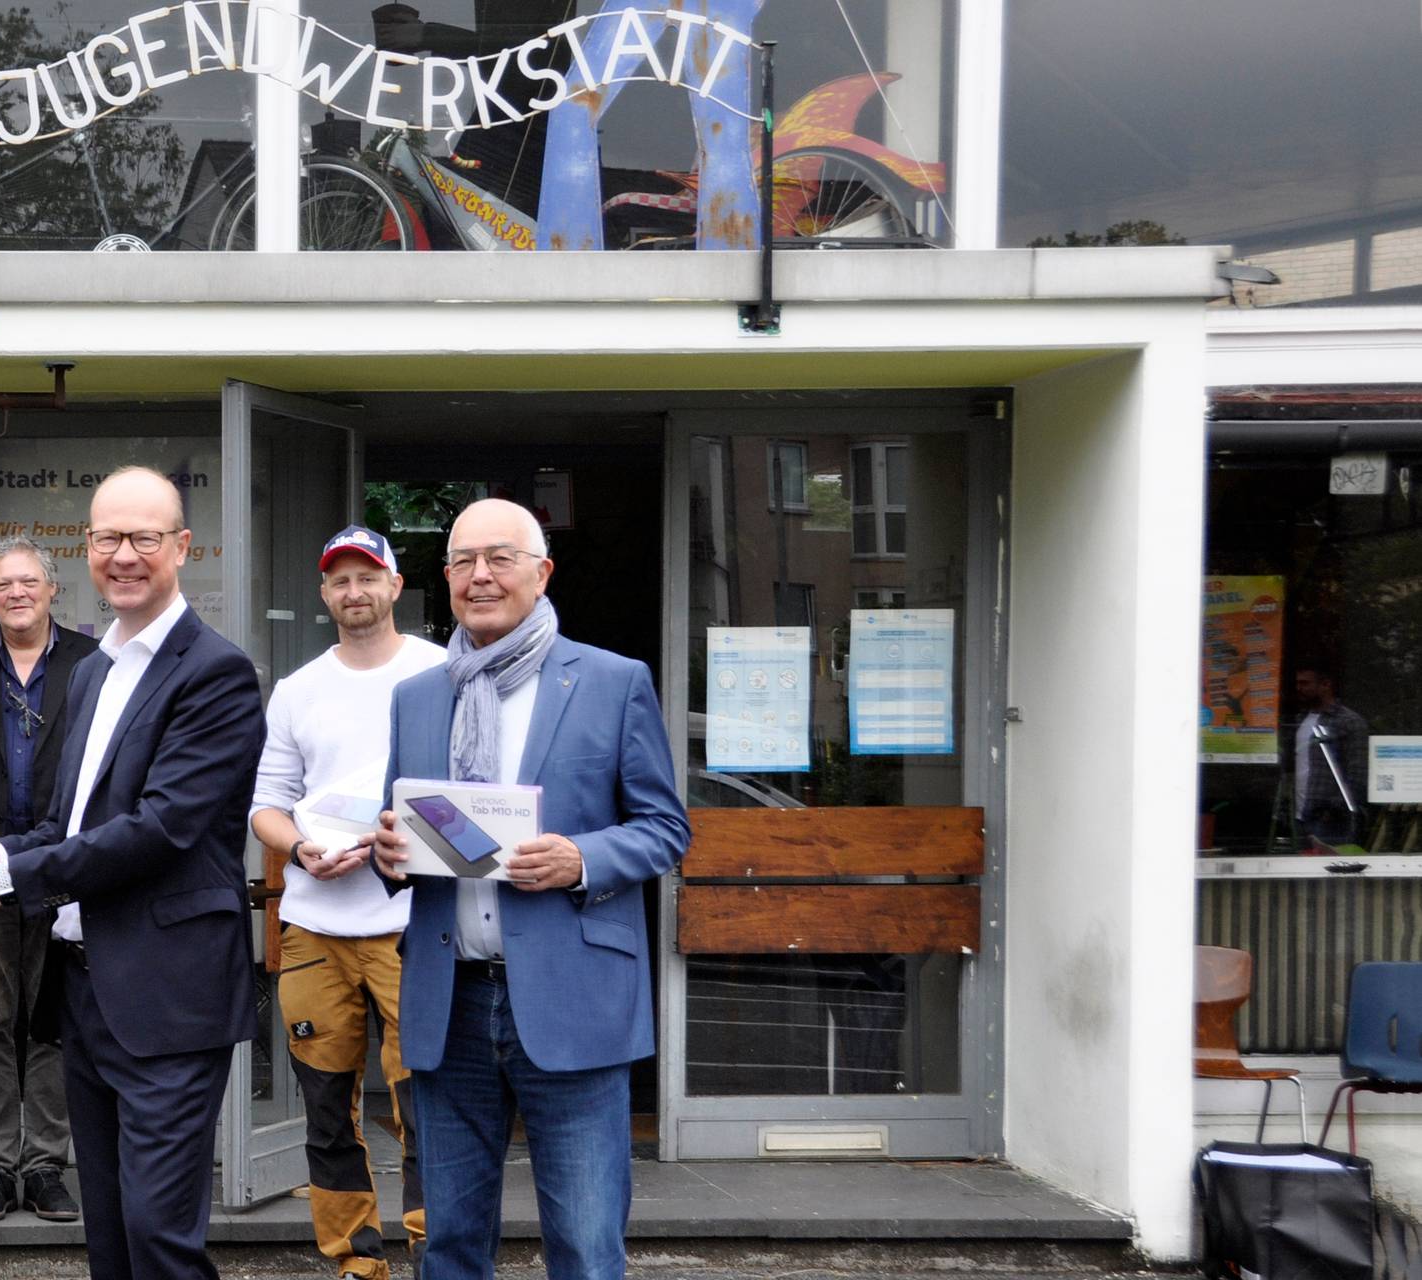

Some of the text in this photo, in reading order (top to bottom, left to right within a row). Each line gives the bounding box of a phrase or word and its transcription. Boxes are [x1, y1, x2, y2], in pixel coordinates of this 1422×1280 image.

[471, 805, 531, 817] Tab M10 HD
